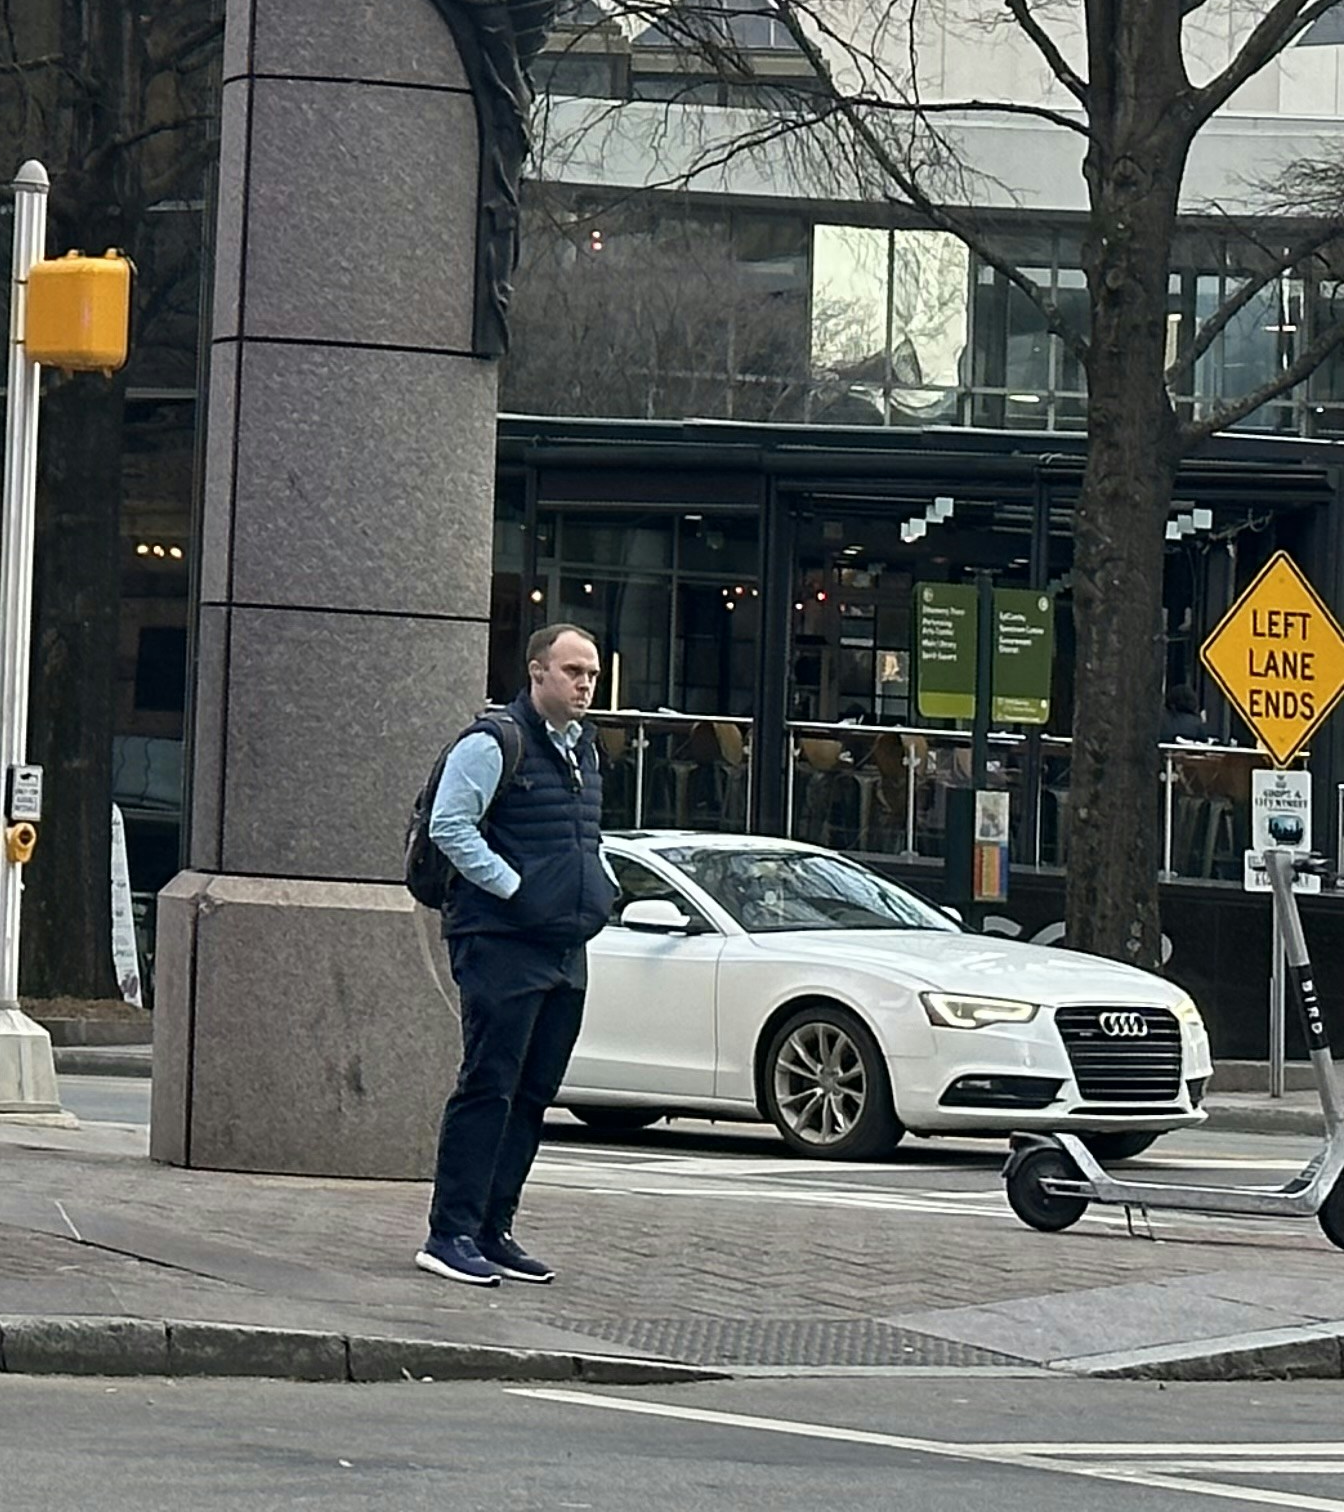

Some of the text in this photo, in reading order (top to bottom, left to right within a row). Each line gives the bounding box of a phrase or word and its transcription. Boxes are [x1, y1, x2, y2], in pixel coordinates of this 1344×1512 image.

[1252, 608, 1312, 641] LEFT
[1249, 647, 1315, 681] LANE
[1249, 689, 1315, 721] ENDS
[1301, 979, 1323, 1035] BIRD
